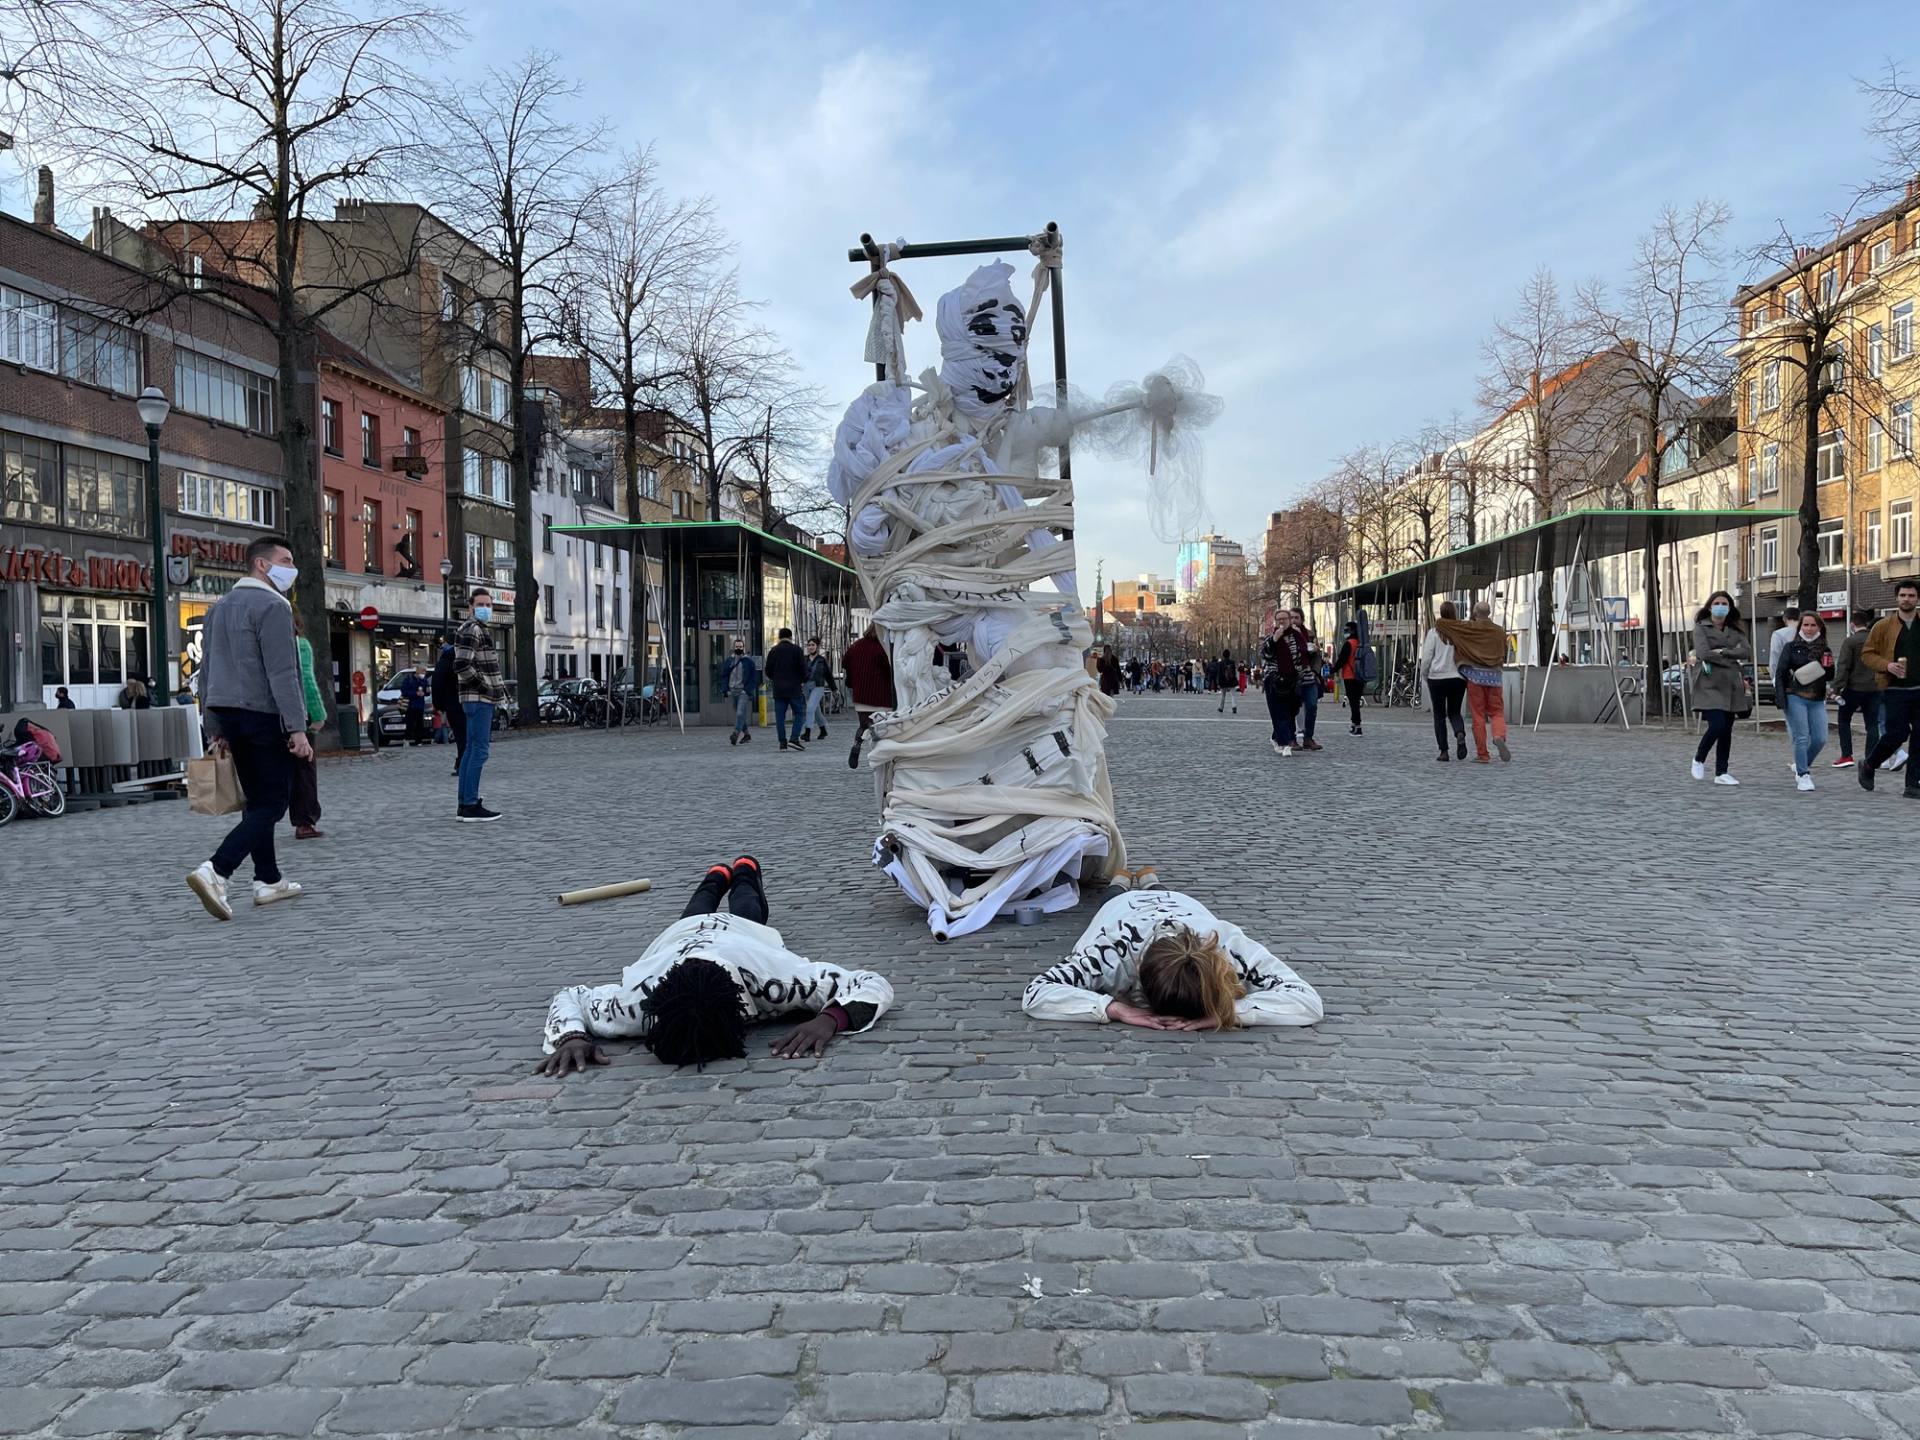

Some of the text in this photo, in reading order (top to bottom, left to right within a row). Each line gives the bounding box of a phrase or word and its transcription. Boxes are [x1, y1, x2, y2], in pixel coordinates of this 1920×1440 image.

[173, 535, 246, 562] RESTAU
[89, 556, 154, 592] RHODE
[738, 966, 841, 1004] DON'T
